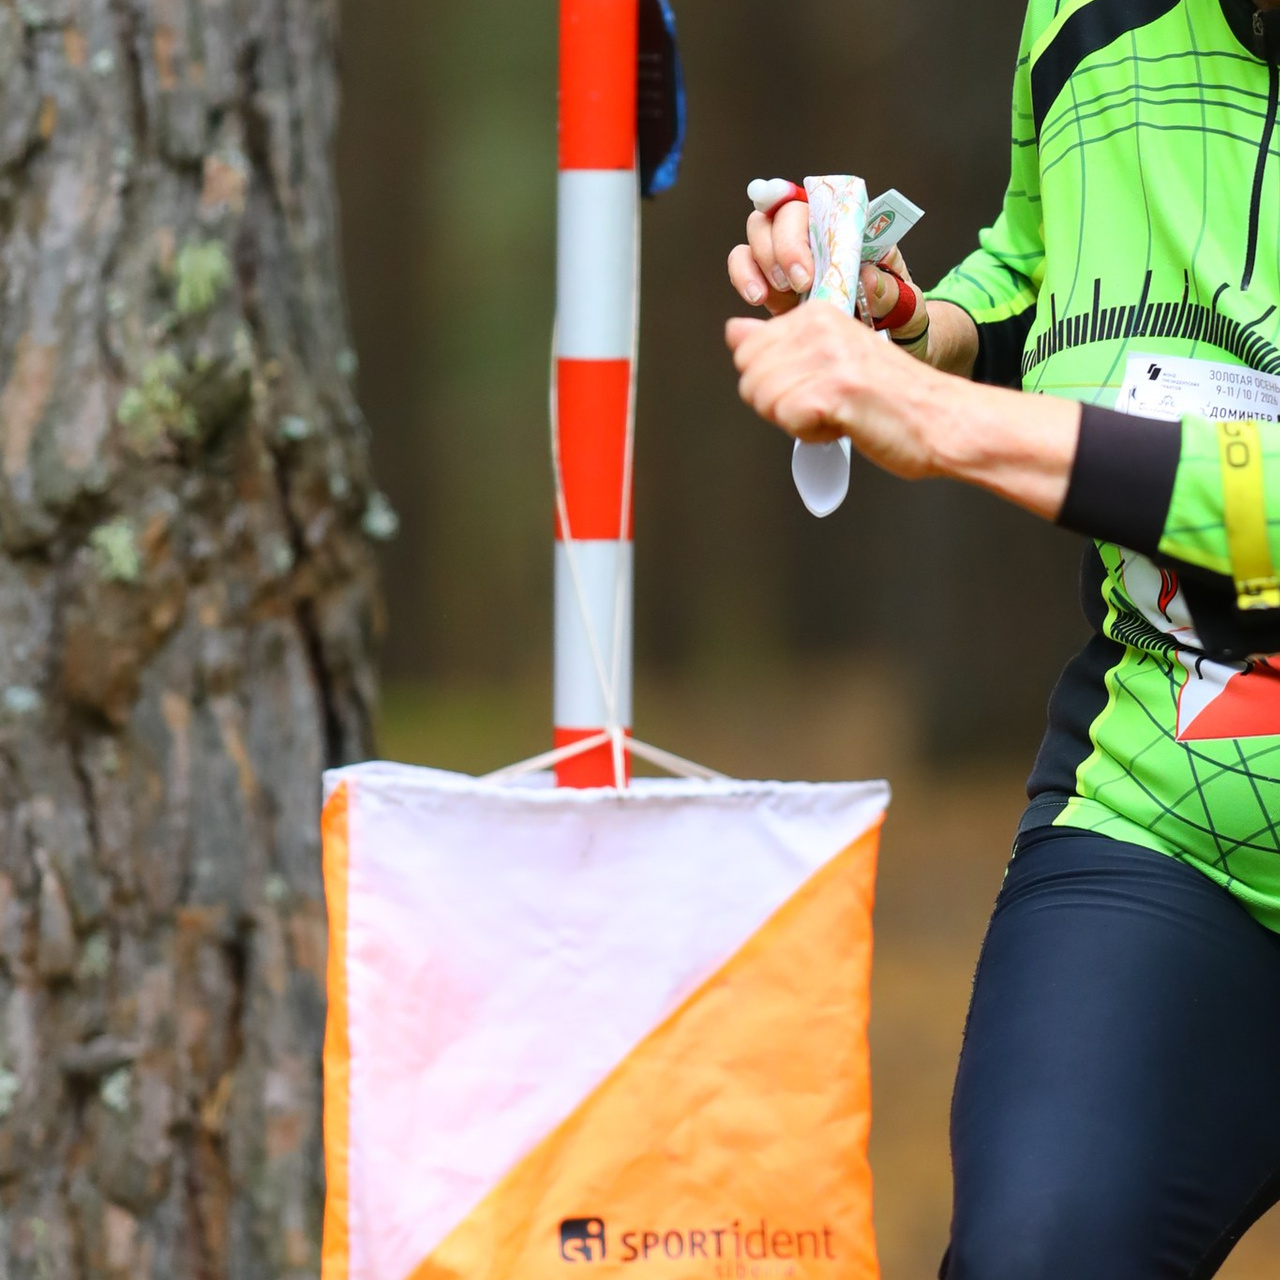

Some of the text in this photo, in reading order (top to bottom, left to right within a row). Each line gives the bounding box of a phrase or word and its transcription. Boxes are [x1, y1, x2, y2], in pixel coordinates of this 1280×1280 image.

[1209, 370, 1280, 393] ЗОЛОТАЯ ОСЕНЬ
[620, 1220, 837, 1262] SPORTident
